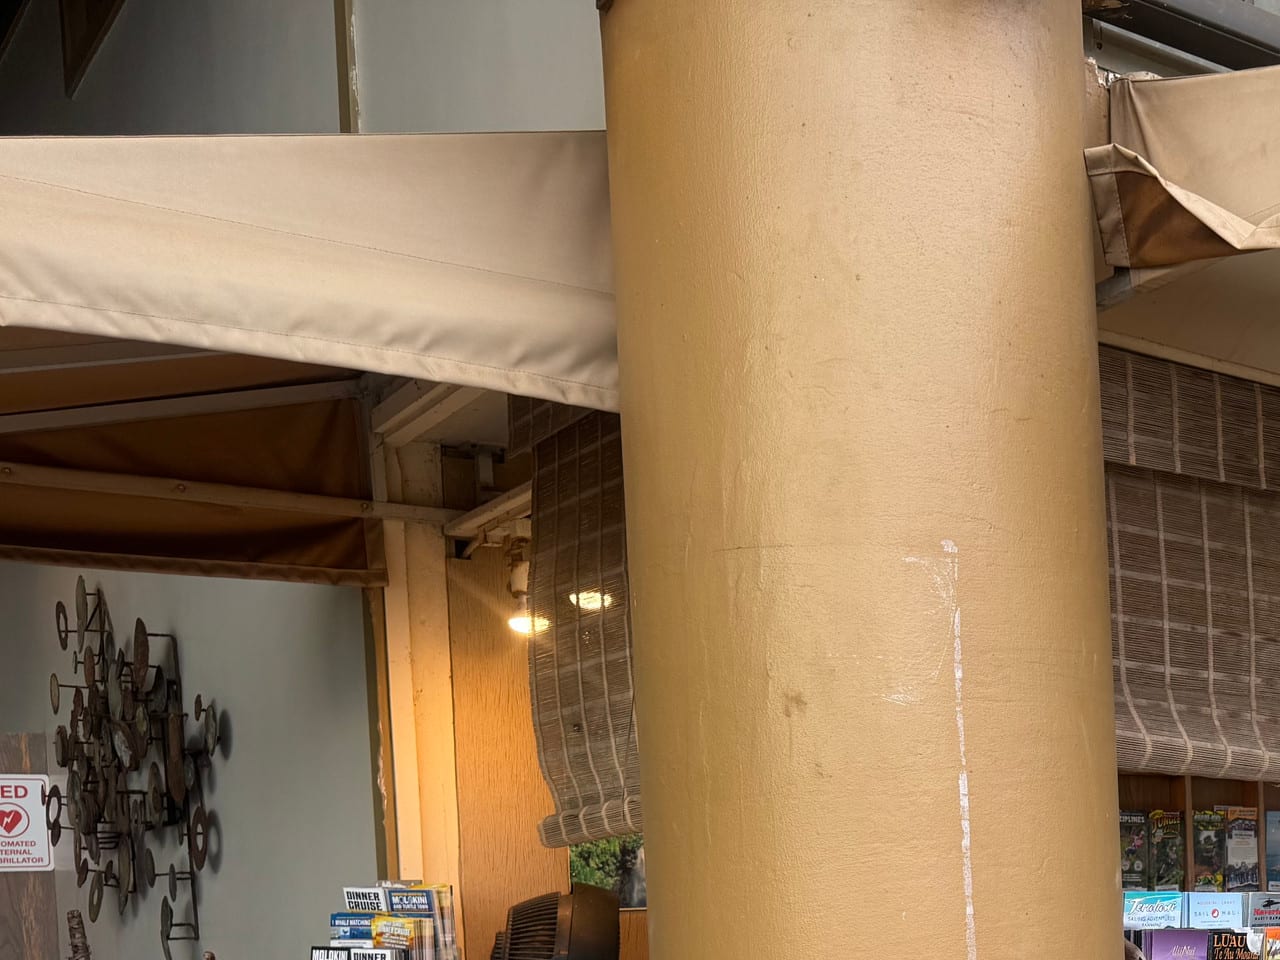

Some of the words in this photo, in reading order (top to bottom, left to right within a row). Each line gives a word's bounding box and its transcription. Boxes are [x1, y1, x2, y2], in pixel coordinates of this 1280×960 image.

[346, 891, 381, 901] DINNER
[348, 900, 383, 911] CRUISE
[311, 949, 348, 960] MOLOKINI
